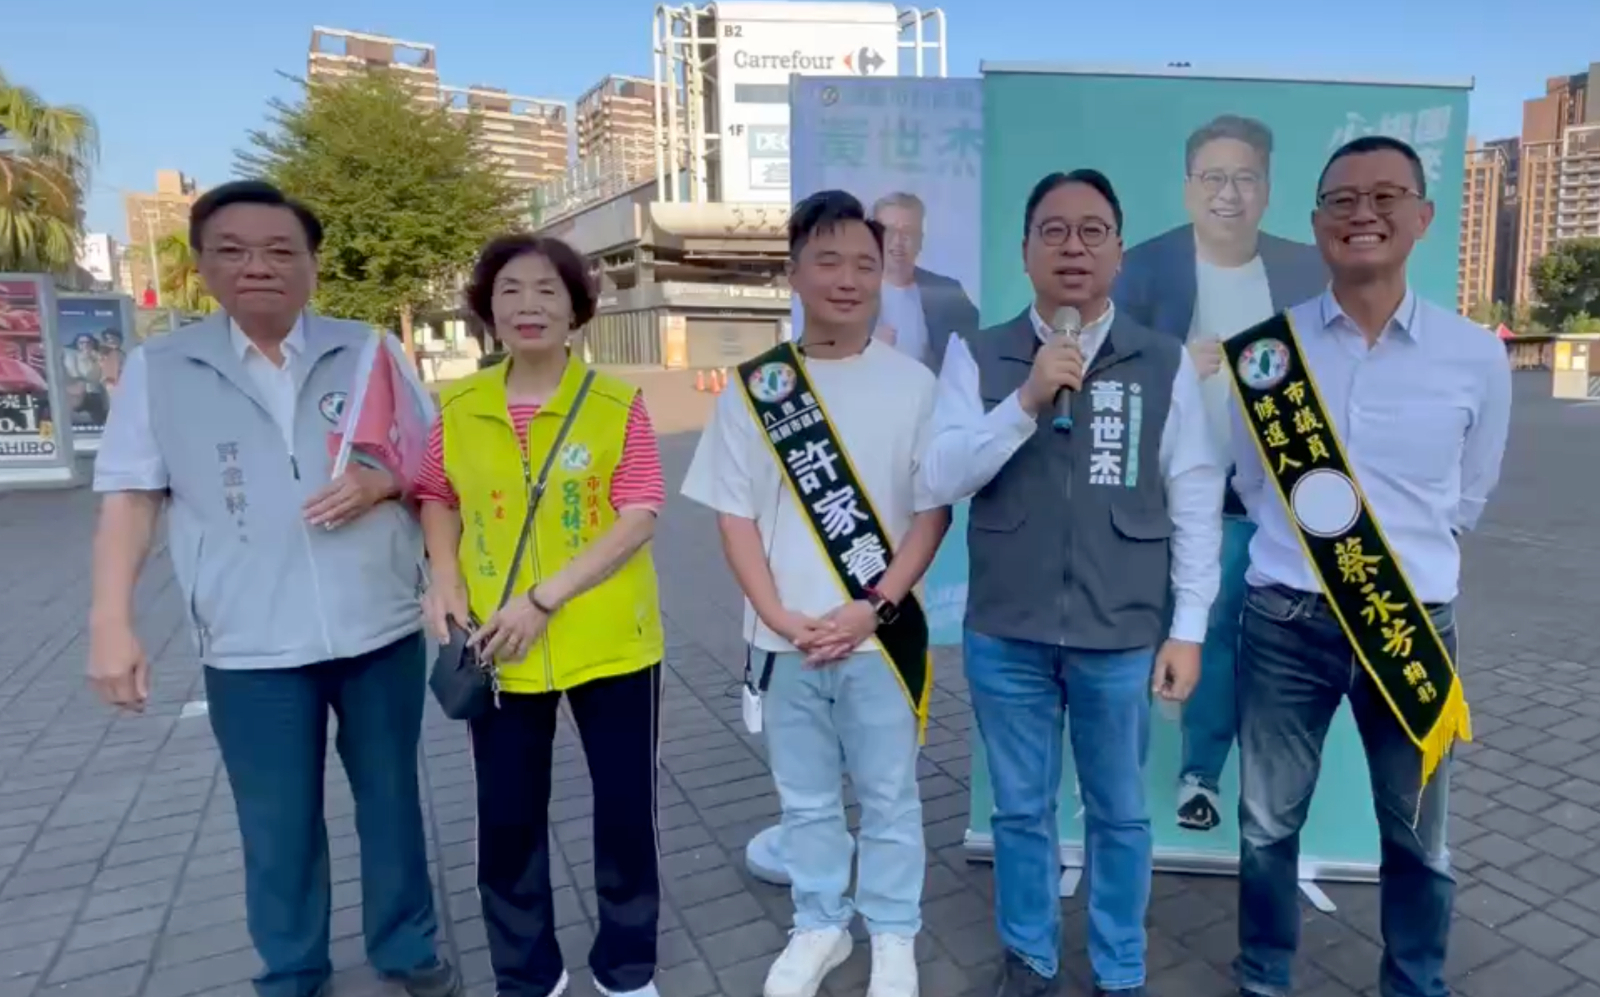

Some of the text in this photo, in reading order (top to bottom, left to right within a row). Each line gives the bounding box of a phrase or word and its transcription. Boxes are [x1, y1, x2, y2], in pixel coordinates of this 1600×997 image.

[724, 25, 743, 37] B2
[734, 50, 835, 70] Carrefour
[728, 124, 744, 136] 1F
[1089, 380, 1124, 485] 黃世杰
[1253, 394, 1303, 475] 候選人
[1283, 380, 1330, 463] 市議員
